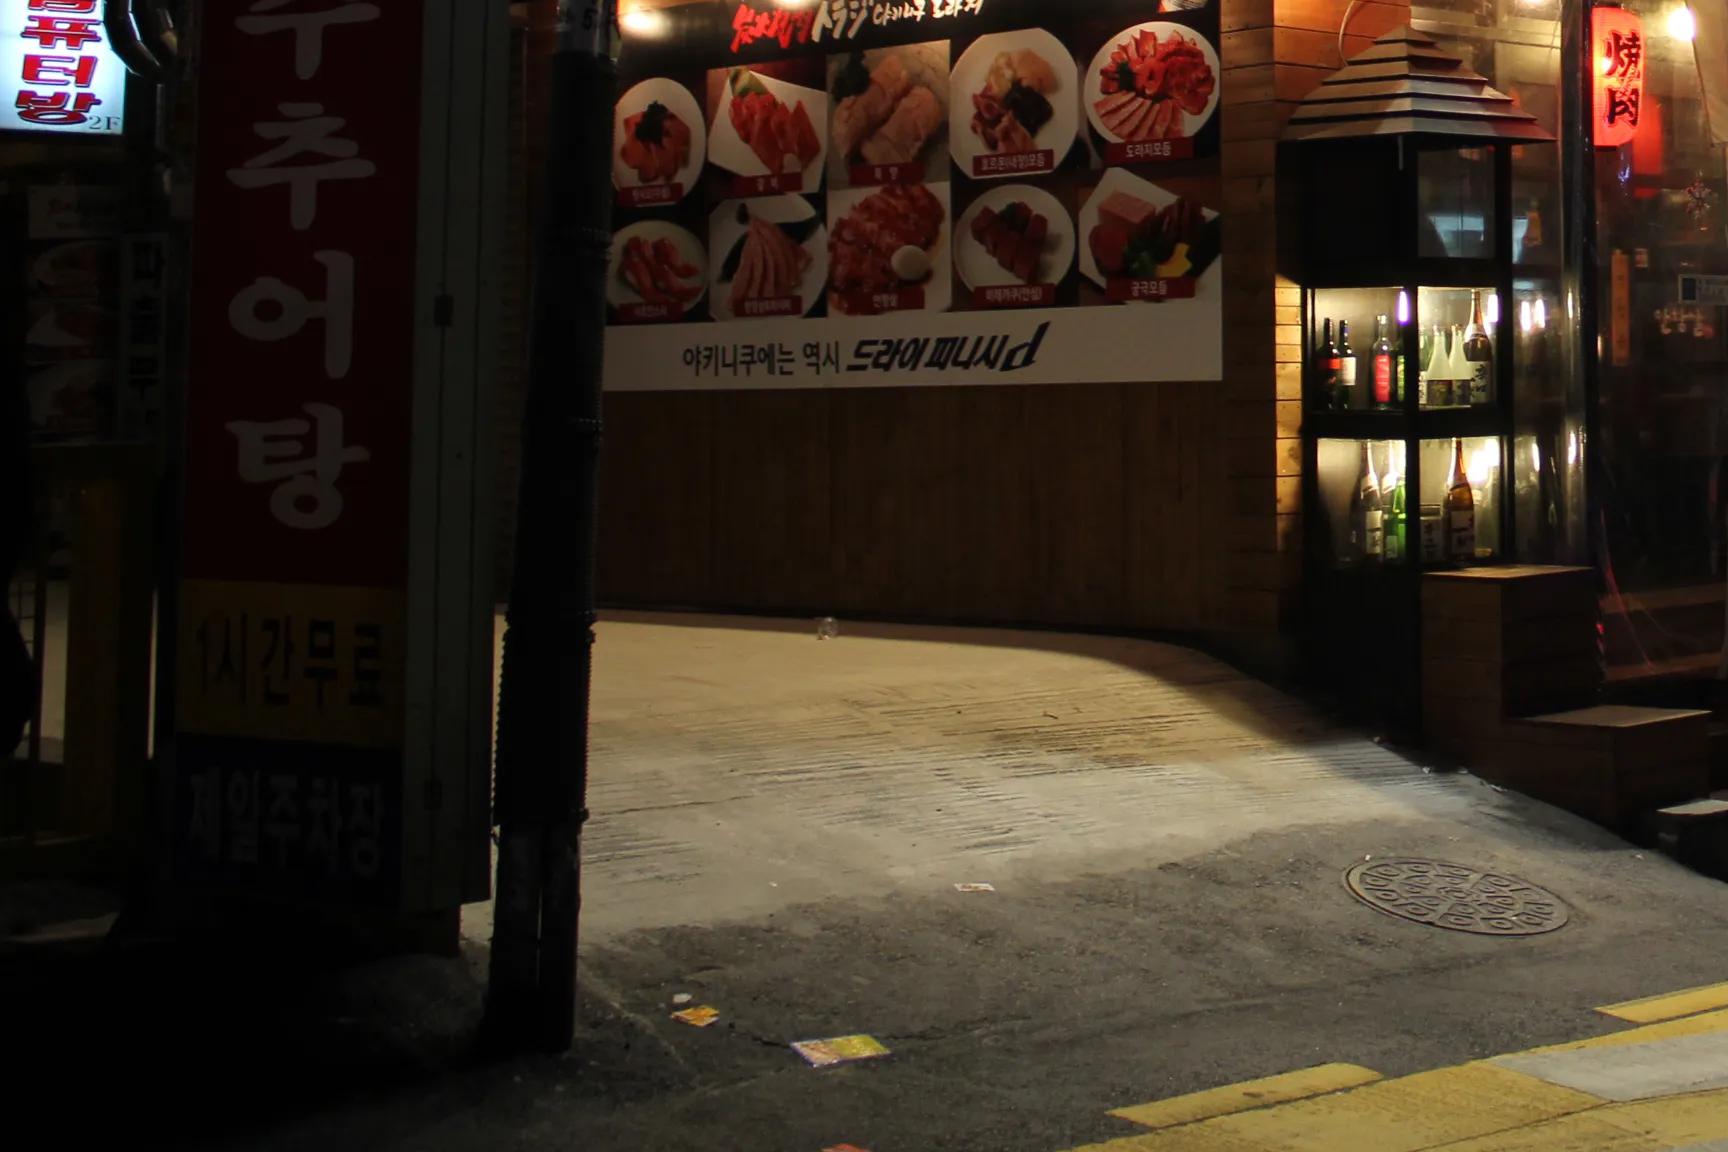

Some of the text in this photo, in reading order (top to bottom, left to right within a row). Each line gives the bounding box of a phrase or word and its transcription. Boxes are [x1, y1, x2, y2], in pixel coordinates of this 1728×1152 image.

[88, 116, 121, 132] 2F
[683, 342, 796, 377] 야키니쿠에는
[803, 340, 841, 375] 역시
